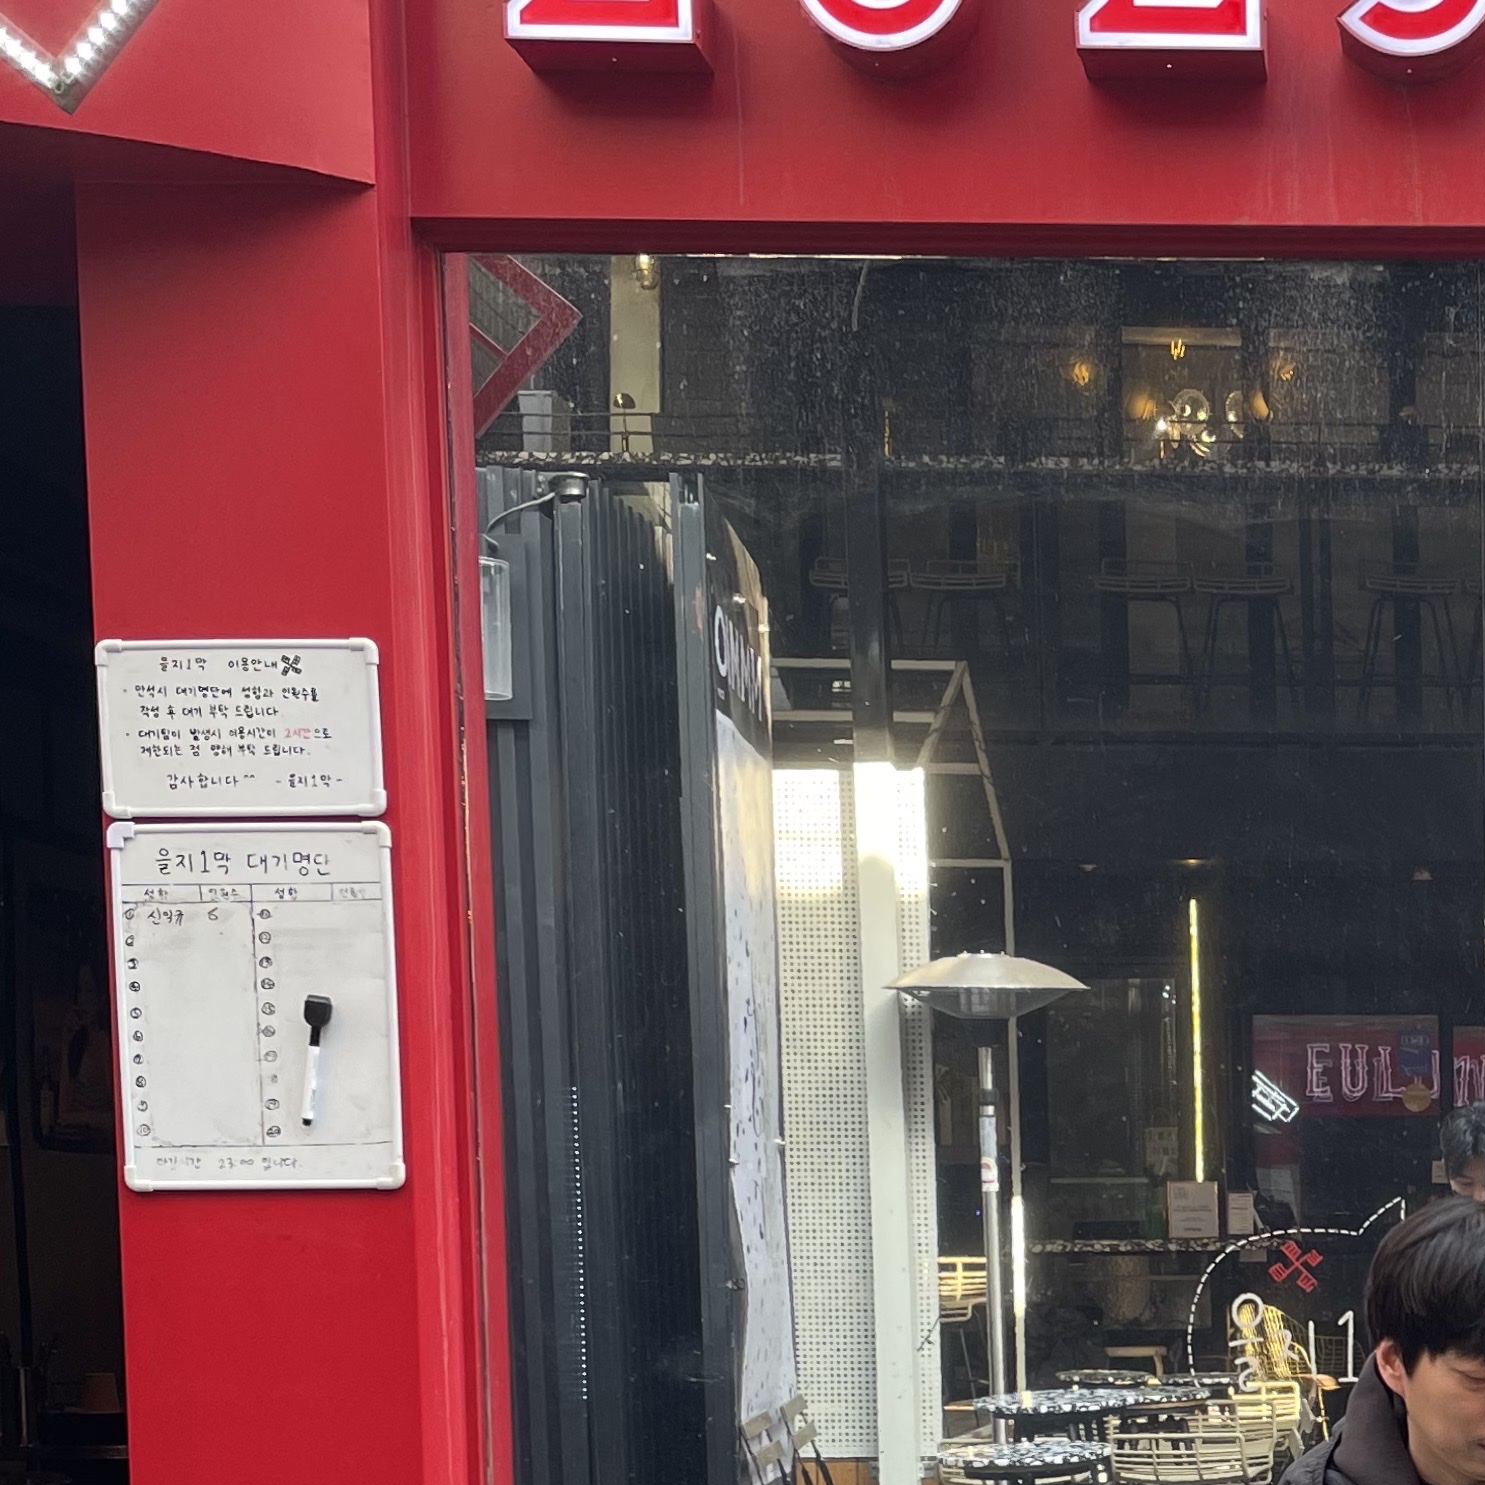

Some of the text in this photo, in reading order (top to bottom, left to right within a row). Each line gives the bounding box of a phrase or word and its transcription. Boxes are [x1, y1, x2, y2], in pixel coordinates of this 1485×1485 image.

[160, 656, 278, 671] 을지1막 이용안내
[135, 686, 319, 701] 만석시 대기명단에 성함과 인원수를
[140, 706, 159, 717] 작성
[183, 707, 202, 717] 대기
[209, 706, 229, 718] 부탁
[235, 706, 279, 718] 드립니다
[138, 729, 180, 740] 대기팀이
[190, 728, 221, 741] 발생시
[229, 727, 276, 740] 이용시간이
[141, 745, 181, 757] 제한되는
[190, 745, 200, 757] 점
[210, 745, 232, 757] 양해
[237, 744, 255, 756] 부탁
[155, 848, 331, 876] 을지1막 대기명단
[208, 907, 218, 921] 6
[1228, 1292, 1359, 1392] 을지1
